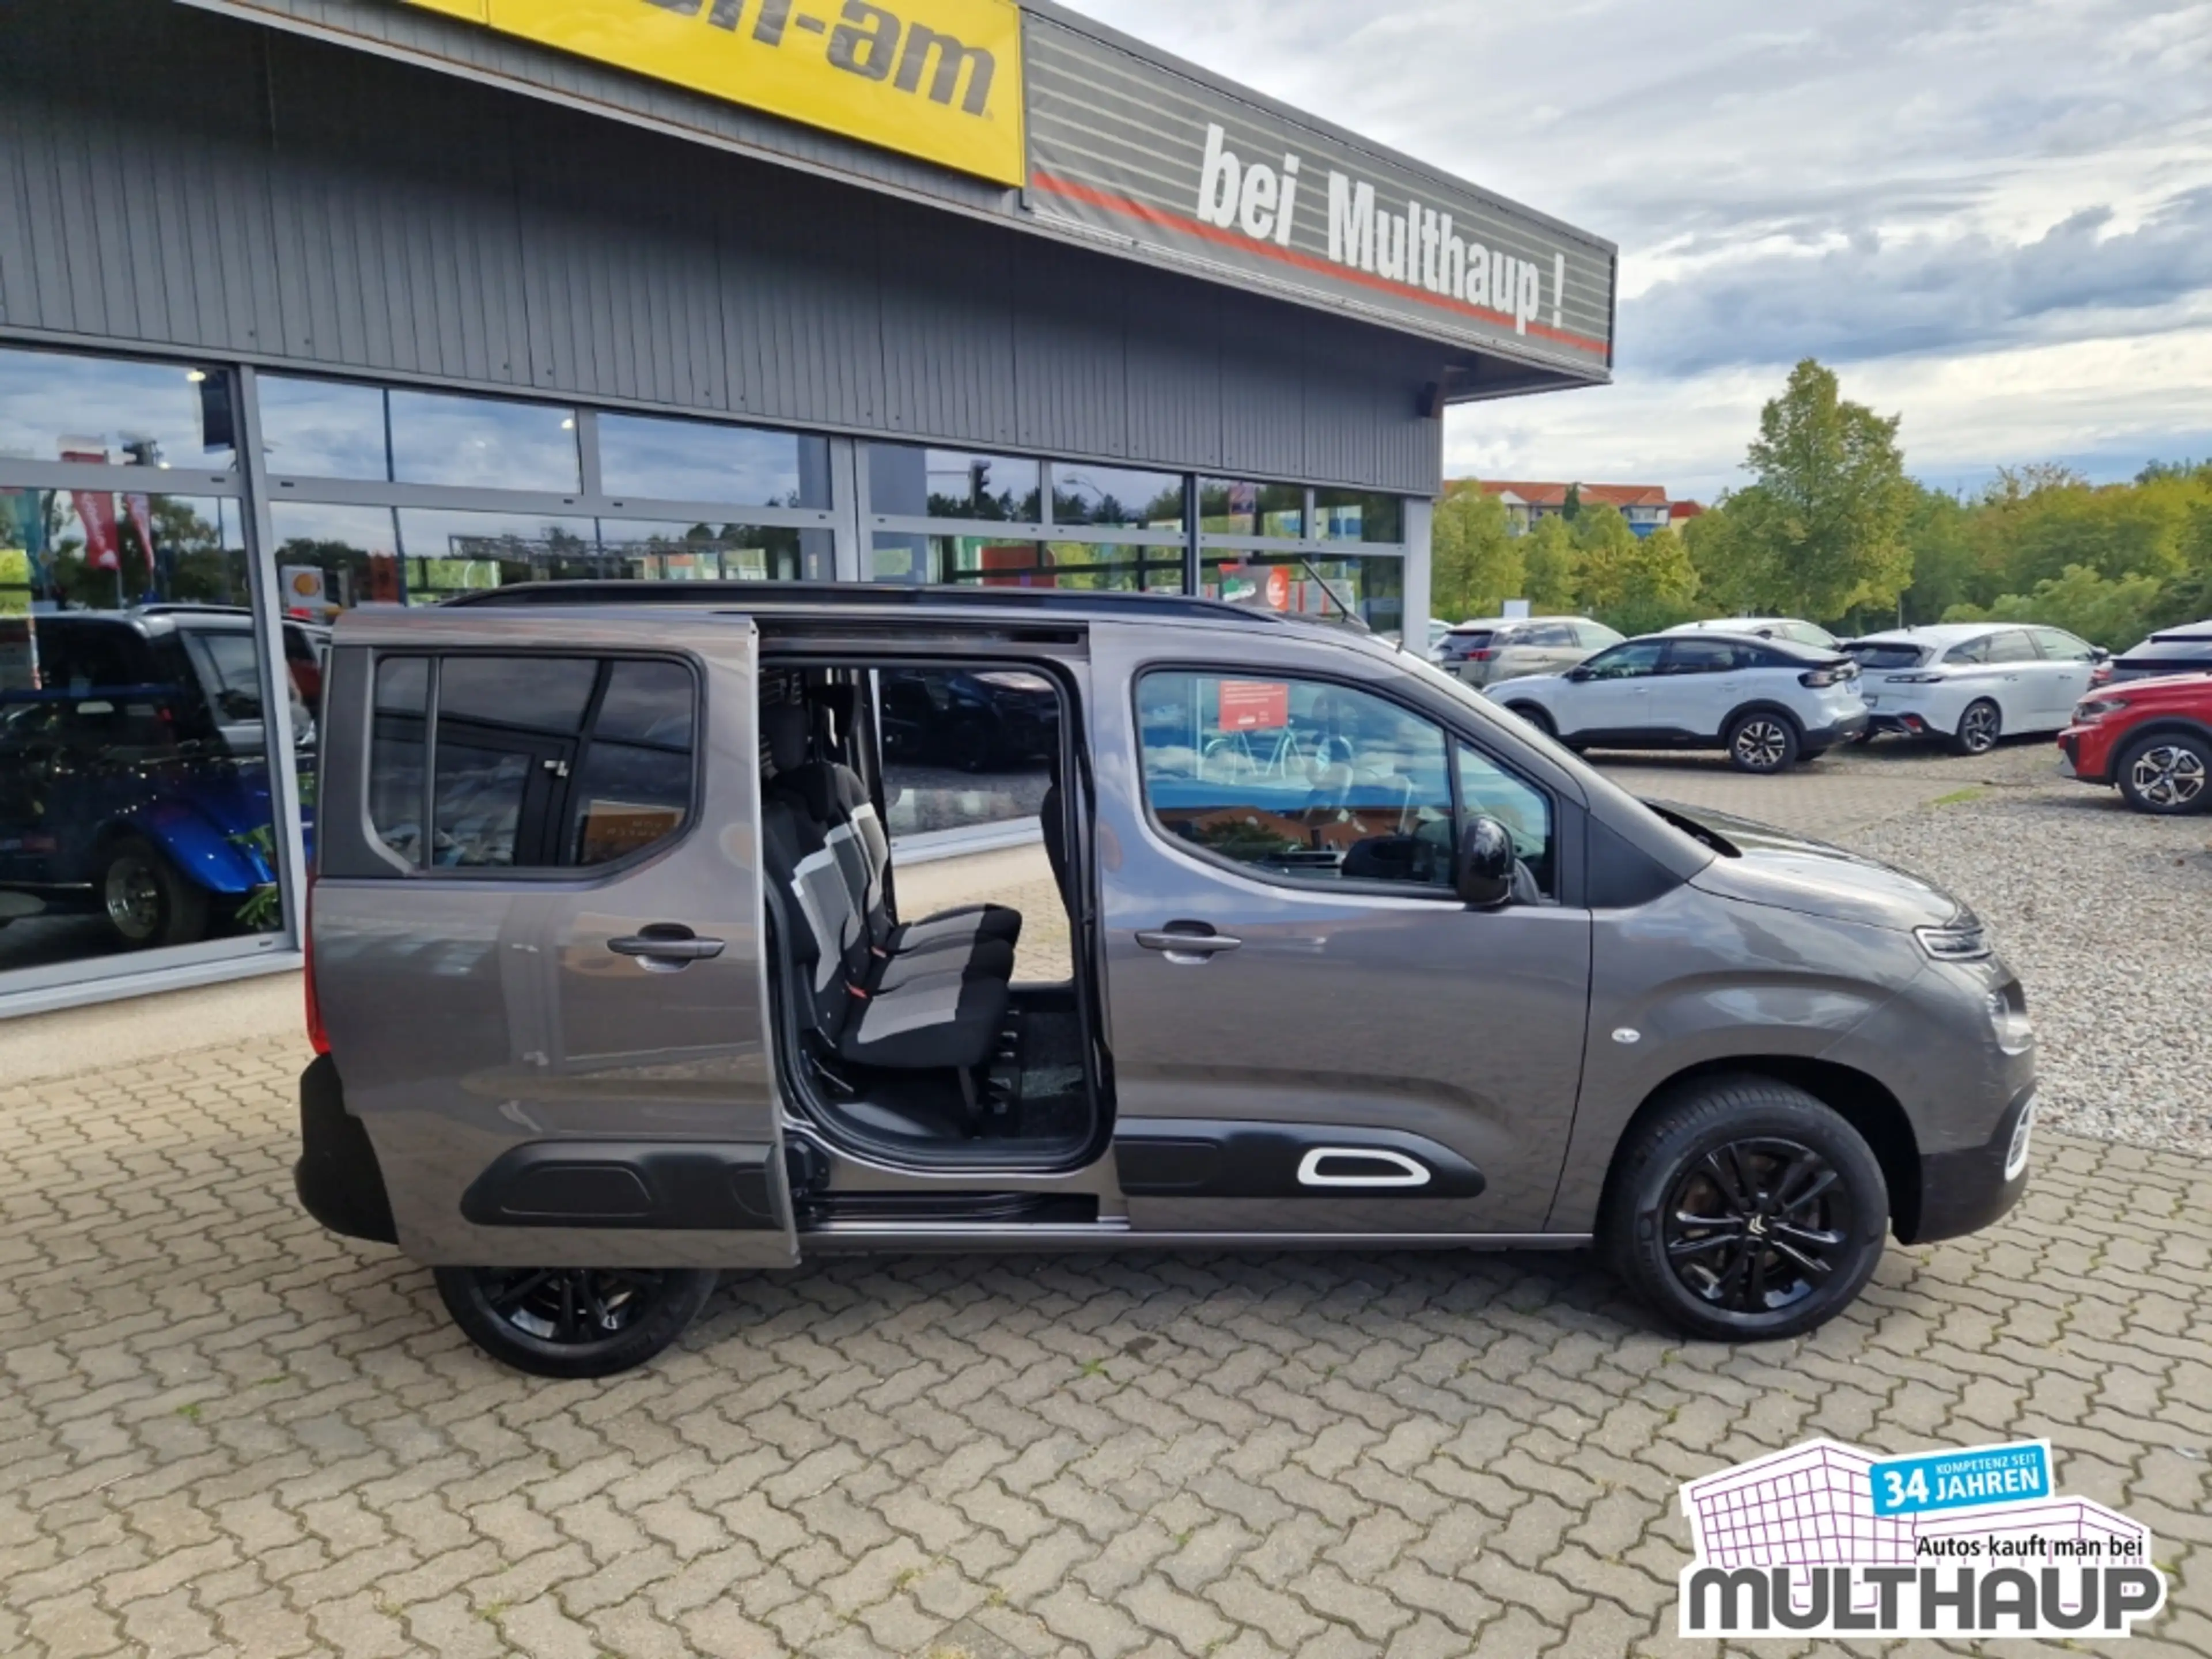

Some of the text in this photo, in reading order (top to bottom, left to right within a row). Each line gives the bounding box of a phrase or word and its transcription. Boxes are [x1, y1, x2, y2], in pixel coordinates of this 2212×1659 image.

[642, 0, 995, 118] -am
[1197, 123, 1565, 335] bei Multhaup !
